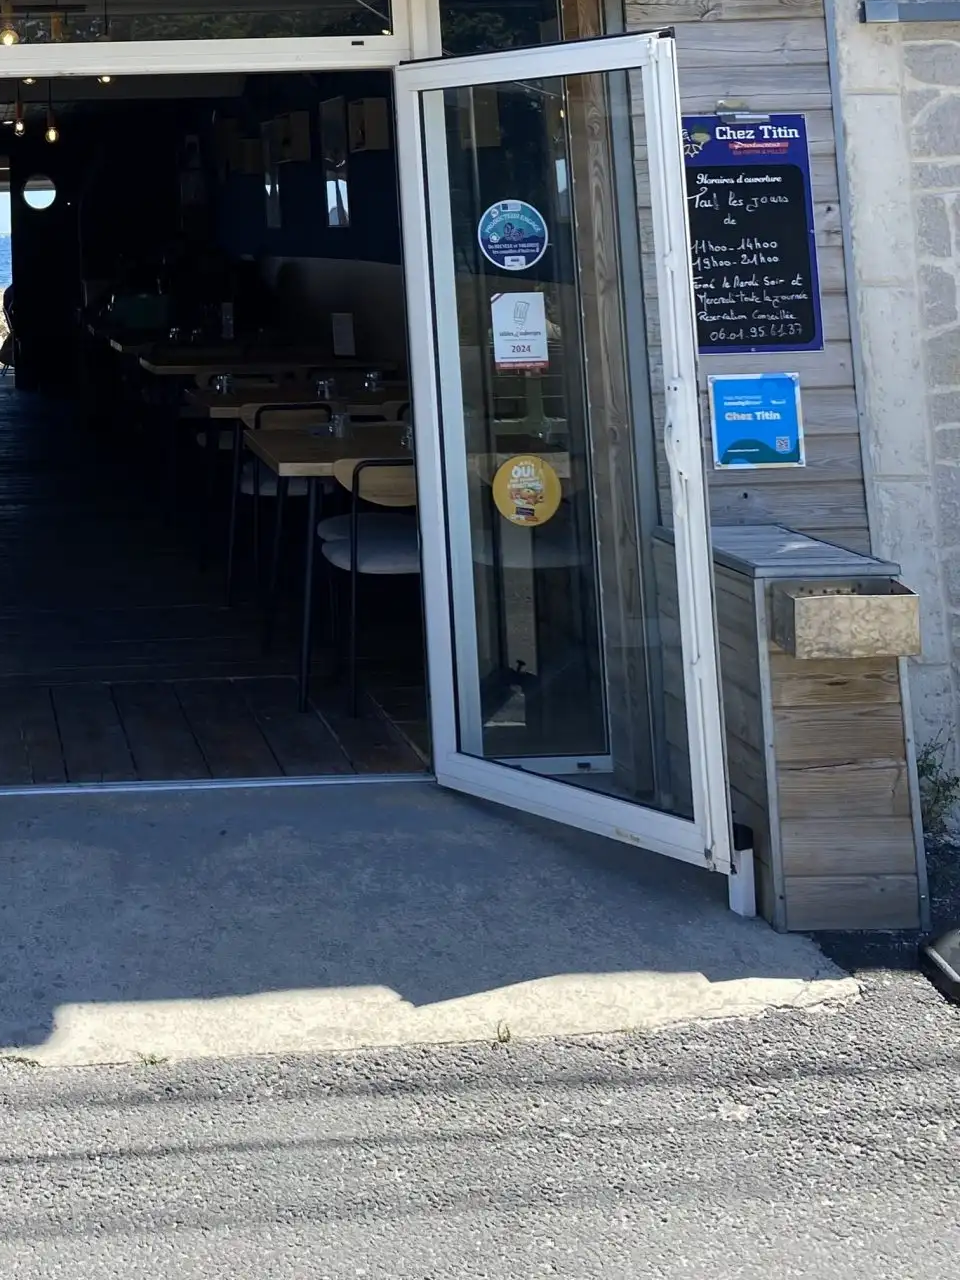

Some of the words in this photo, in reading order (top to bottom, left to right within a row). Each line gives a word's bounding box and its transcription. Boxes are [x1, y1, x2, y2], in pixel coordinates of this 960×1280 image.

[715, 126, 755, 140] Chez
[759, 125, 800, 139] Titin
[728, 190, 744, 206] les
[723, 213, 737, 225] de
[511, 344, 531, 353] 2024
[725, 411, 753, 421] Chez
[754, 410, 781, 420] Titin
